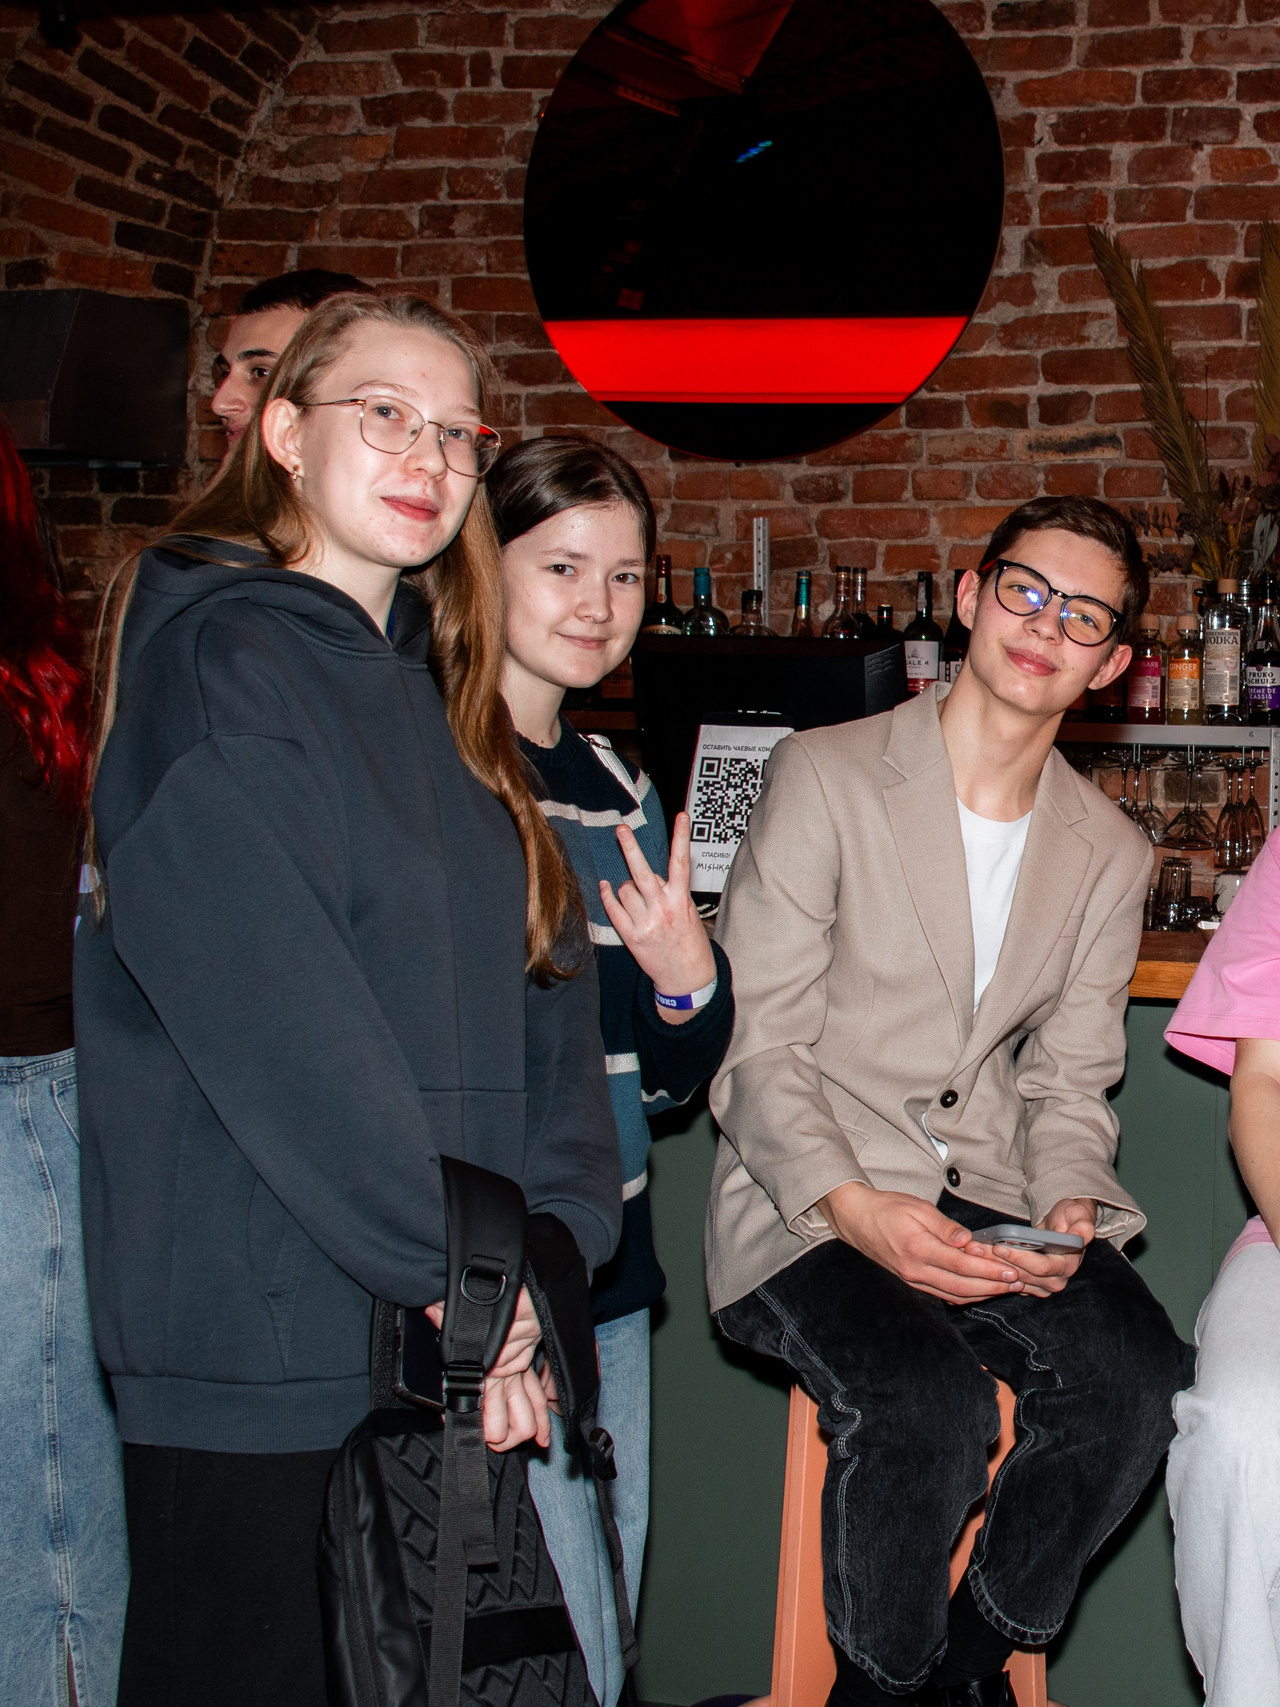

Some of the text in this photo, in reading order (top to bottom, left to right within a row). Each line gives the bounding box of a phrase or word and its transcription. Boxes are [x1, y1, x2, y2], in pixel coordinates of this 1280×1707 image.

[1170, 663, 1198, 671] GINGER
[702, 743, 732, 751] ОСТАВИТЬ
[701, 851, 731, 859] СПАСИБО!
